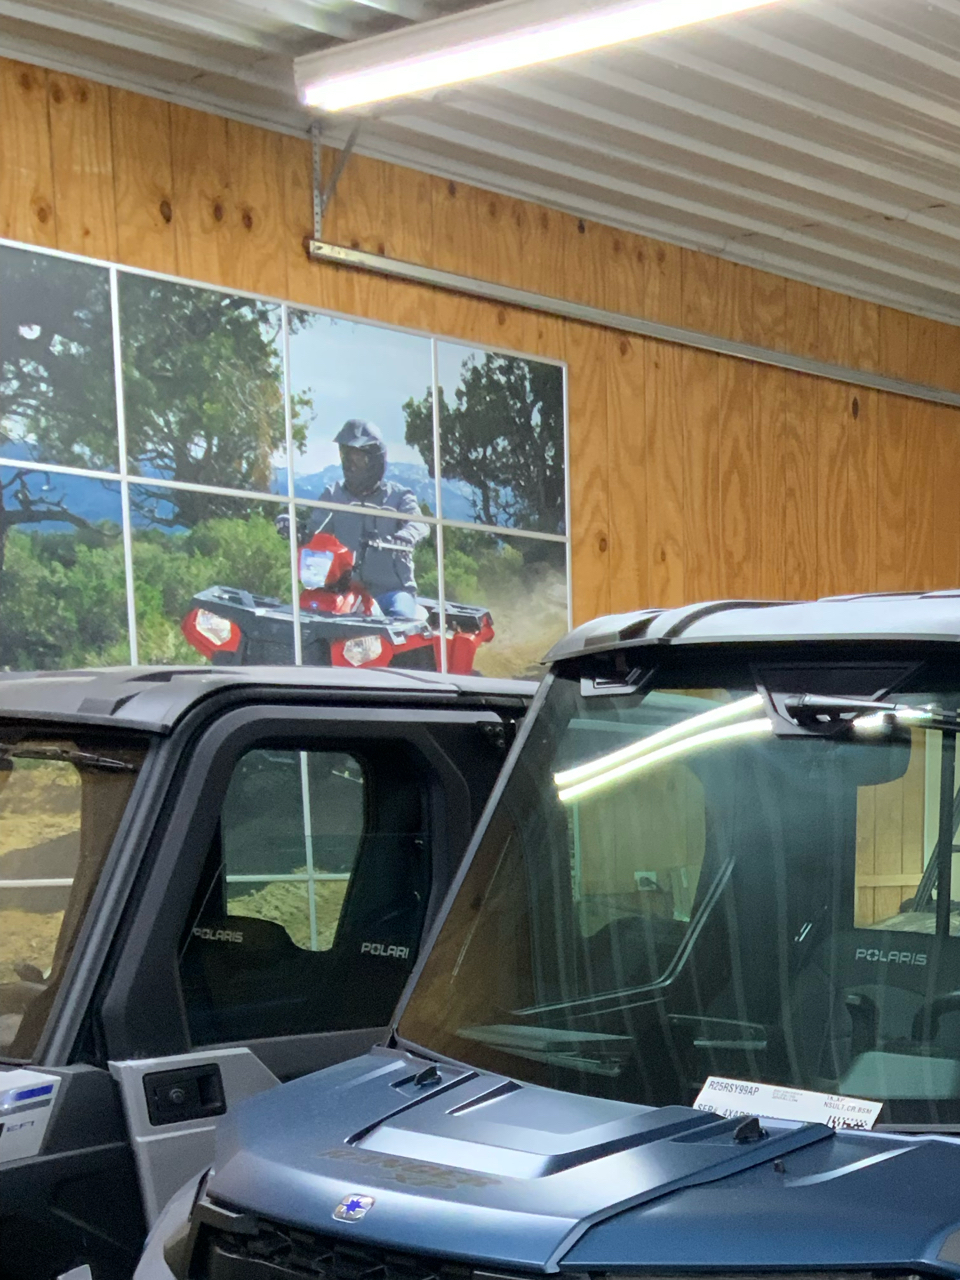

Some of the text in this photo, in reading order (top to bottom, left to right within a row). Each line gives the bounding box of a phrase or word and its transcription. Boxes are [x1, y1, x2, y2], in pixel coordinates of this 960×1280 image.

[192, 927, 243, 943] POLARIS
[361, 942, 409, 959] POLARI
[855, 948, 928, 966] POLARIS
